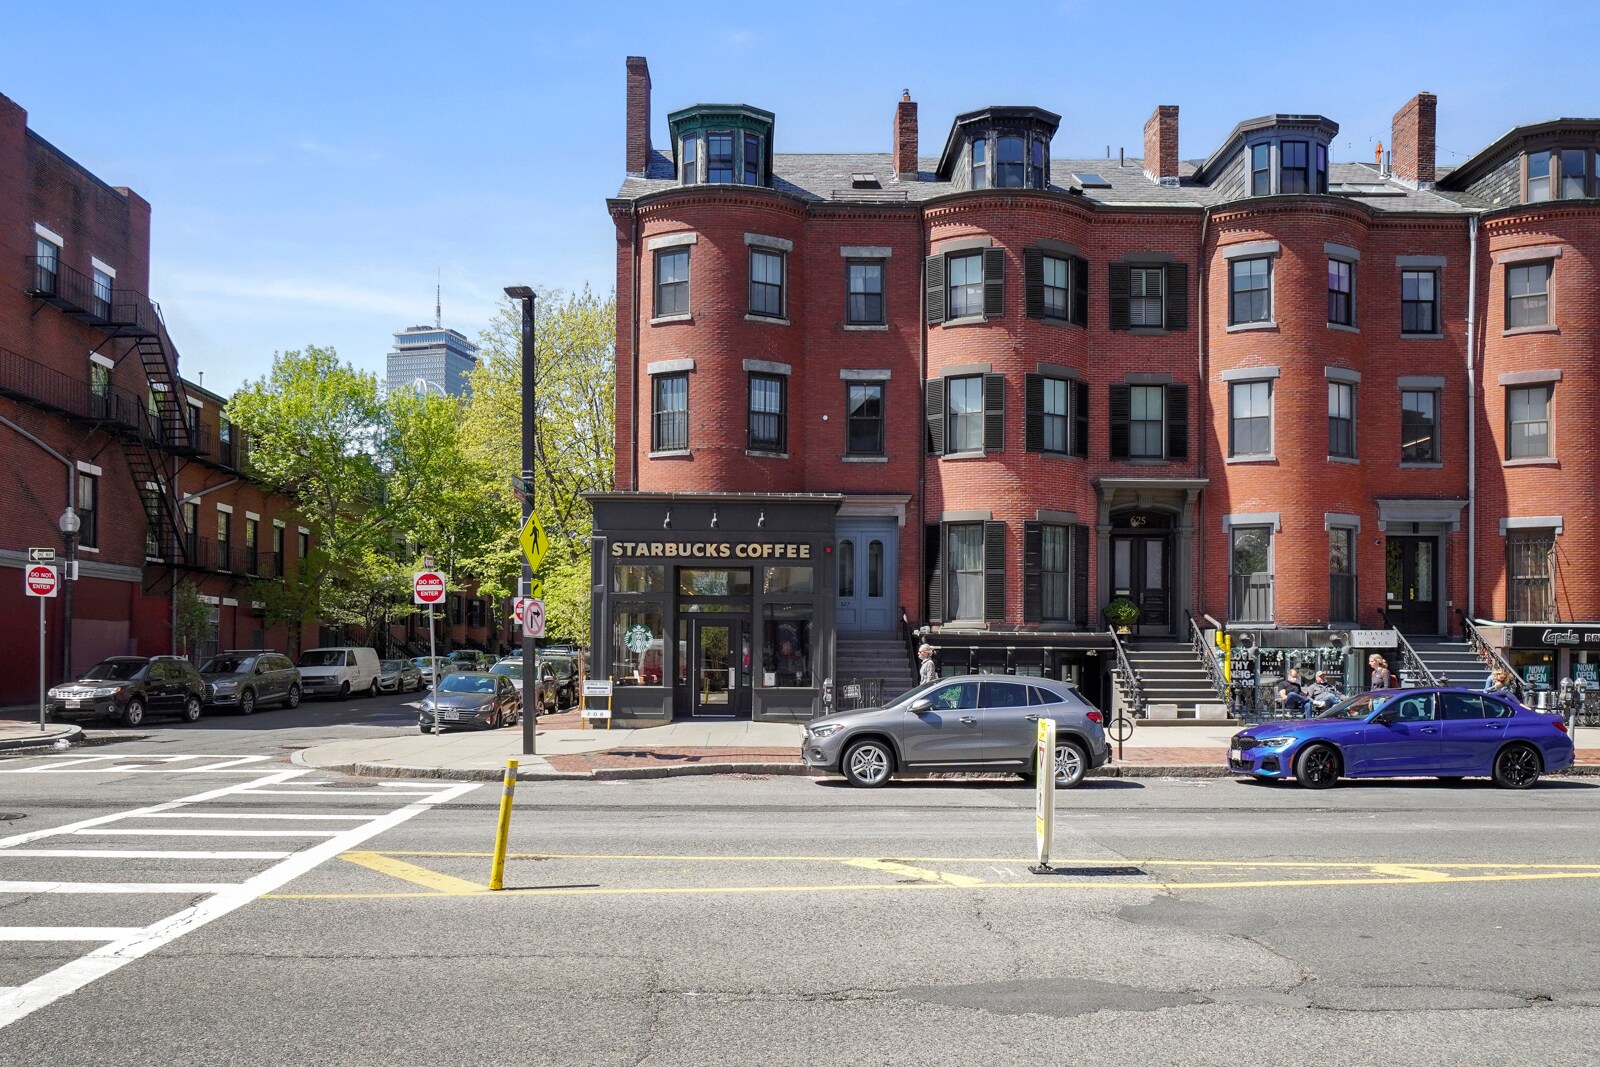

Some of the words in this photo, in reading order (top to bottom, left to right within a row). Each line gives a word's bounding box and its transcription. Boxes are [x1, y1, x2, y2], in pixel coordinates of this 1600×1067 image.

[1130, 516, 1146, 525] 625
[611, 542, 730, 558] STARBUCKS
[735, 543, 811, 559] COFFEE
[1542, 628, 1580, 646] Lapels
[1584, 633, 1600, 642] DR
[1230, 661, 1249, 670] THY
[1528, 666, 1546, 674] NOW
[1577, 664, 1594, 672] NOW
[1576, 672, 1596, 680] OPEN
